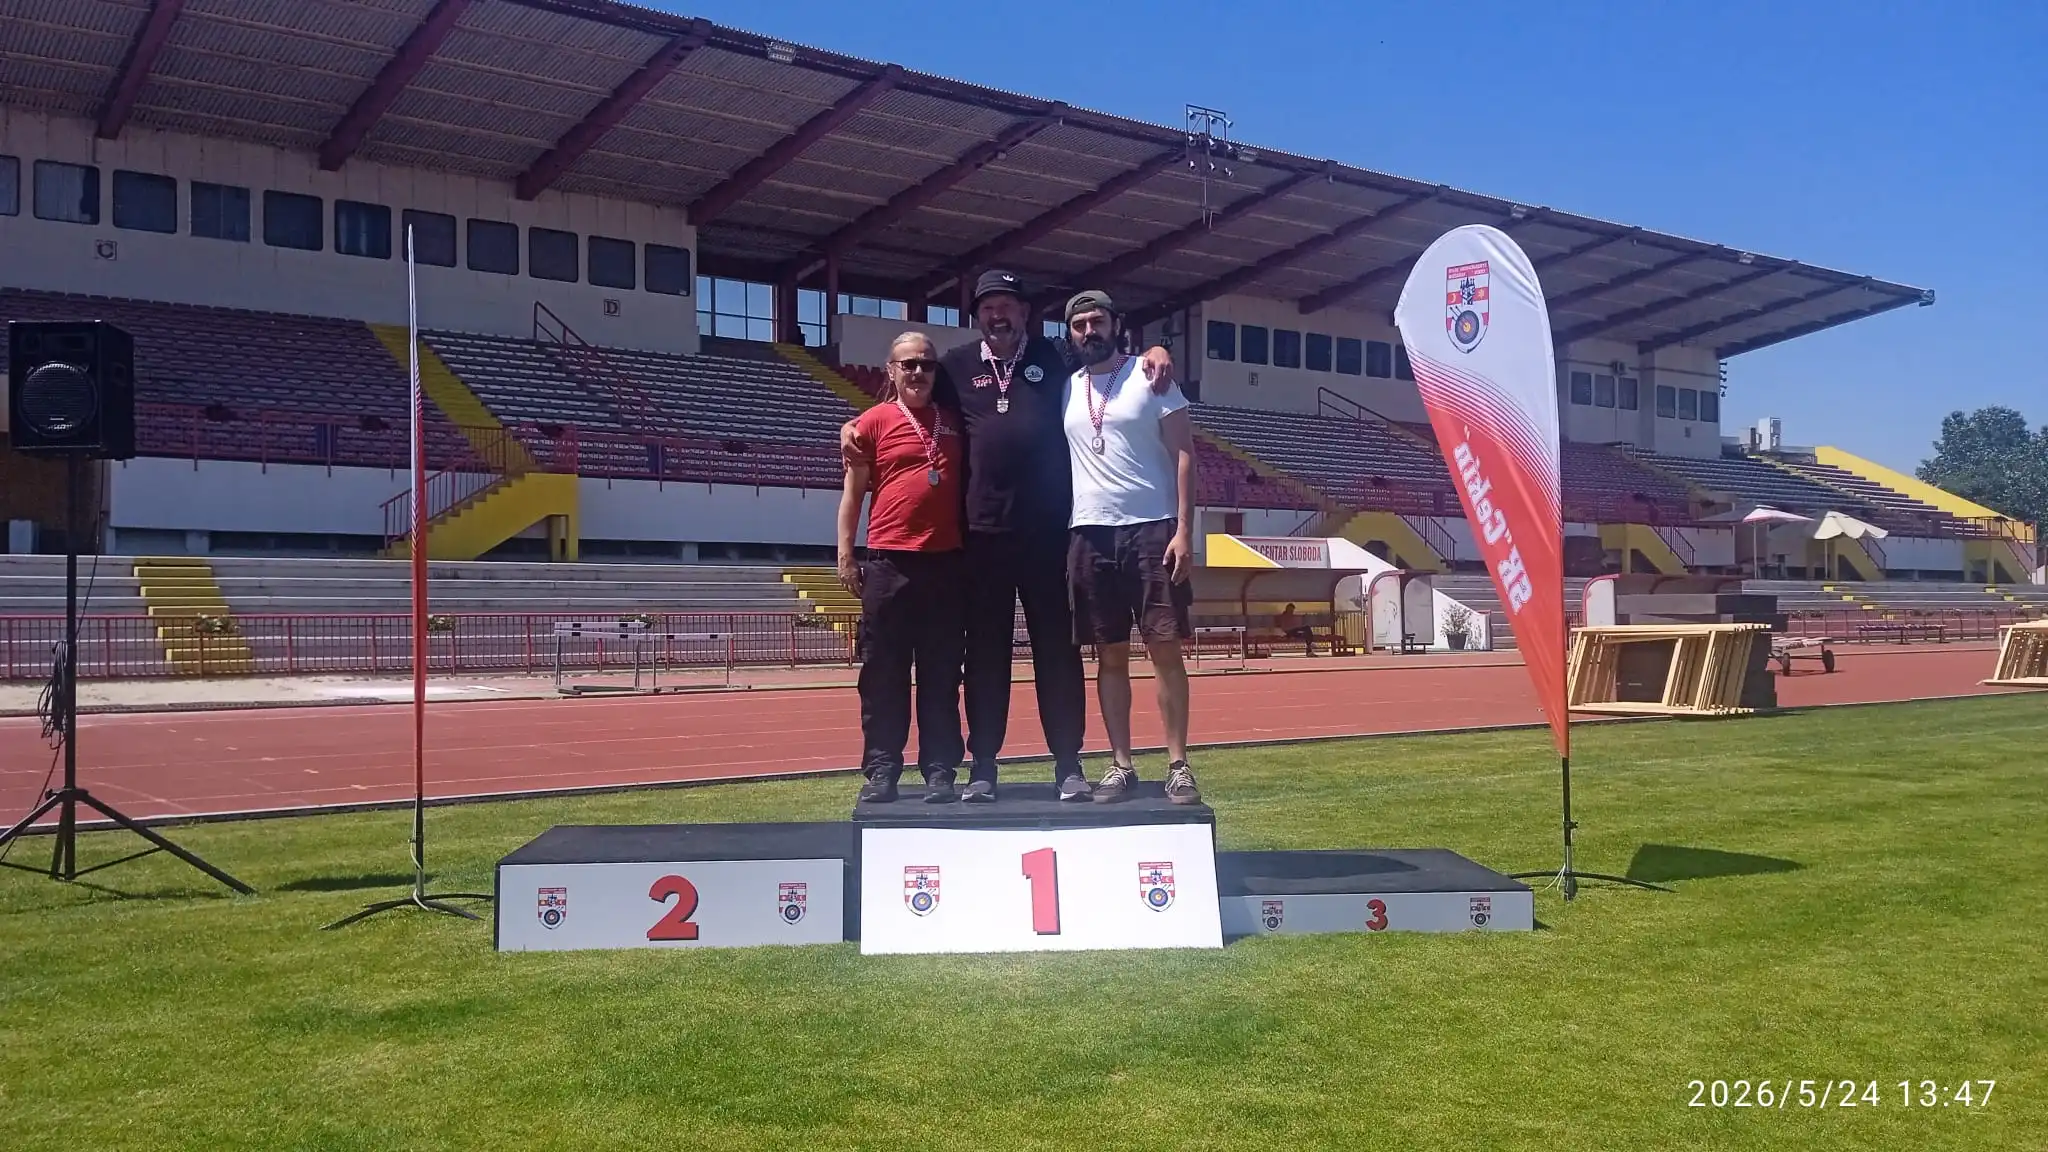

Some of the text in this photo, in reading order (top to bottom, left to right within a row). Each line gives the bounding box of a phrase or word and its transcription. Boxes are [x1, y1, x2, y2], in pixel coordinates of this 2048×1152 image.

[605, 300, 618, 314] D
[1260, 545, 1287, 561] CENTAR
[1289, 545, 1322, 562] SLOBODA
[1021, 847, 1061, 935] 1
[647, 874, 699, 941] 2
[1365, 898, 1388, 930] 3
